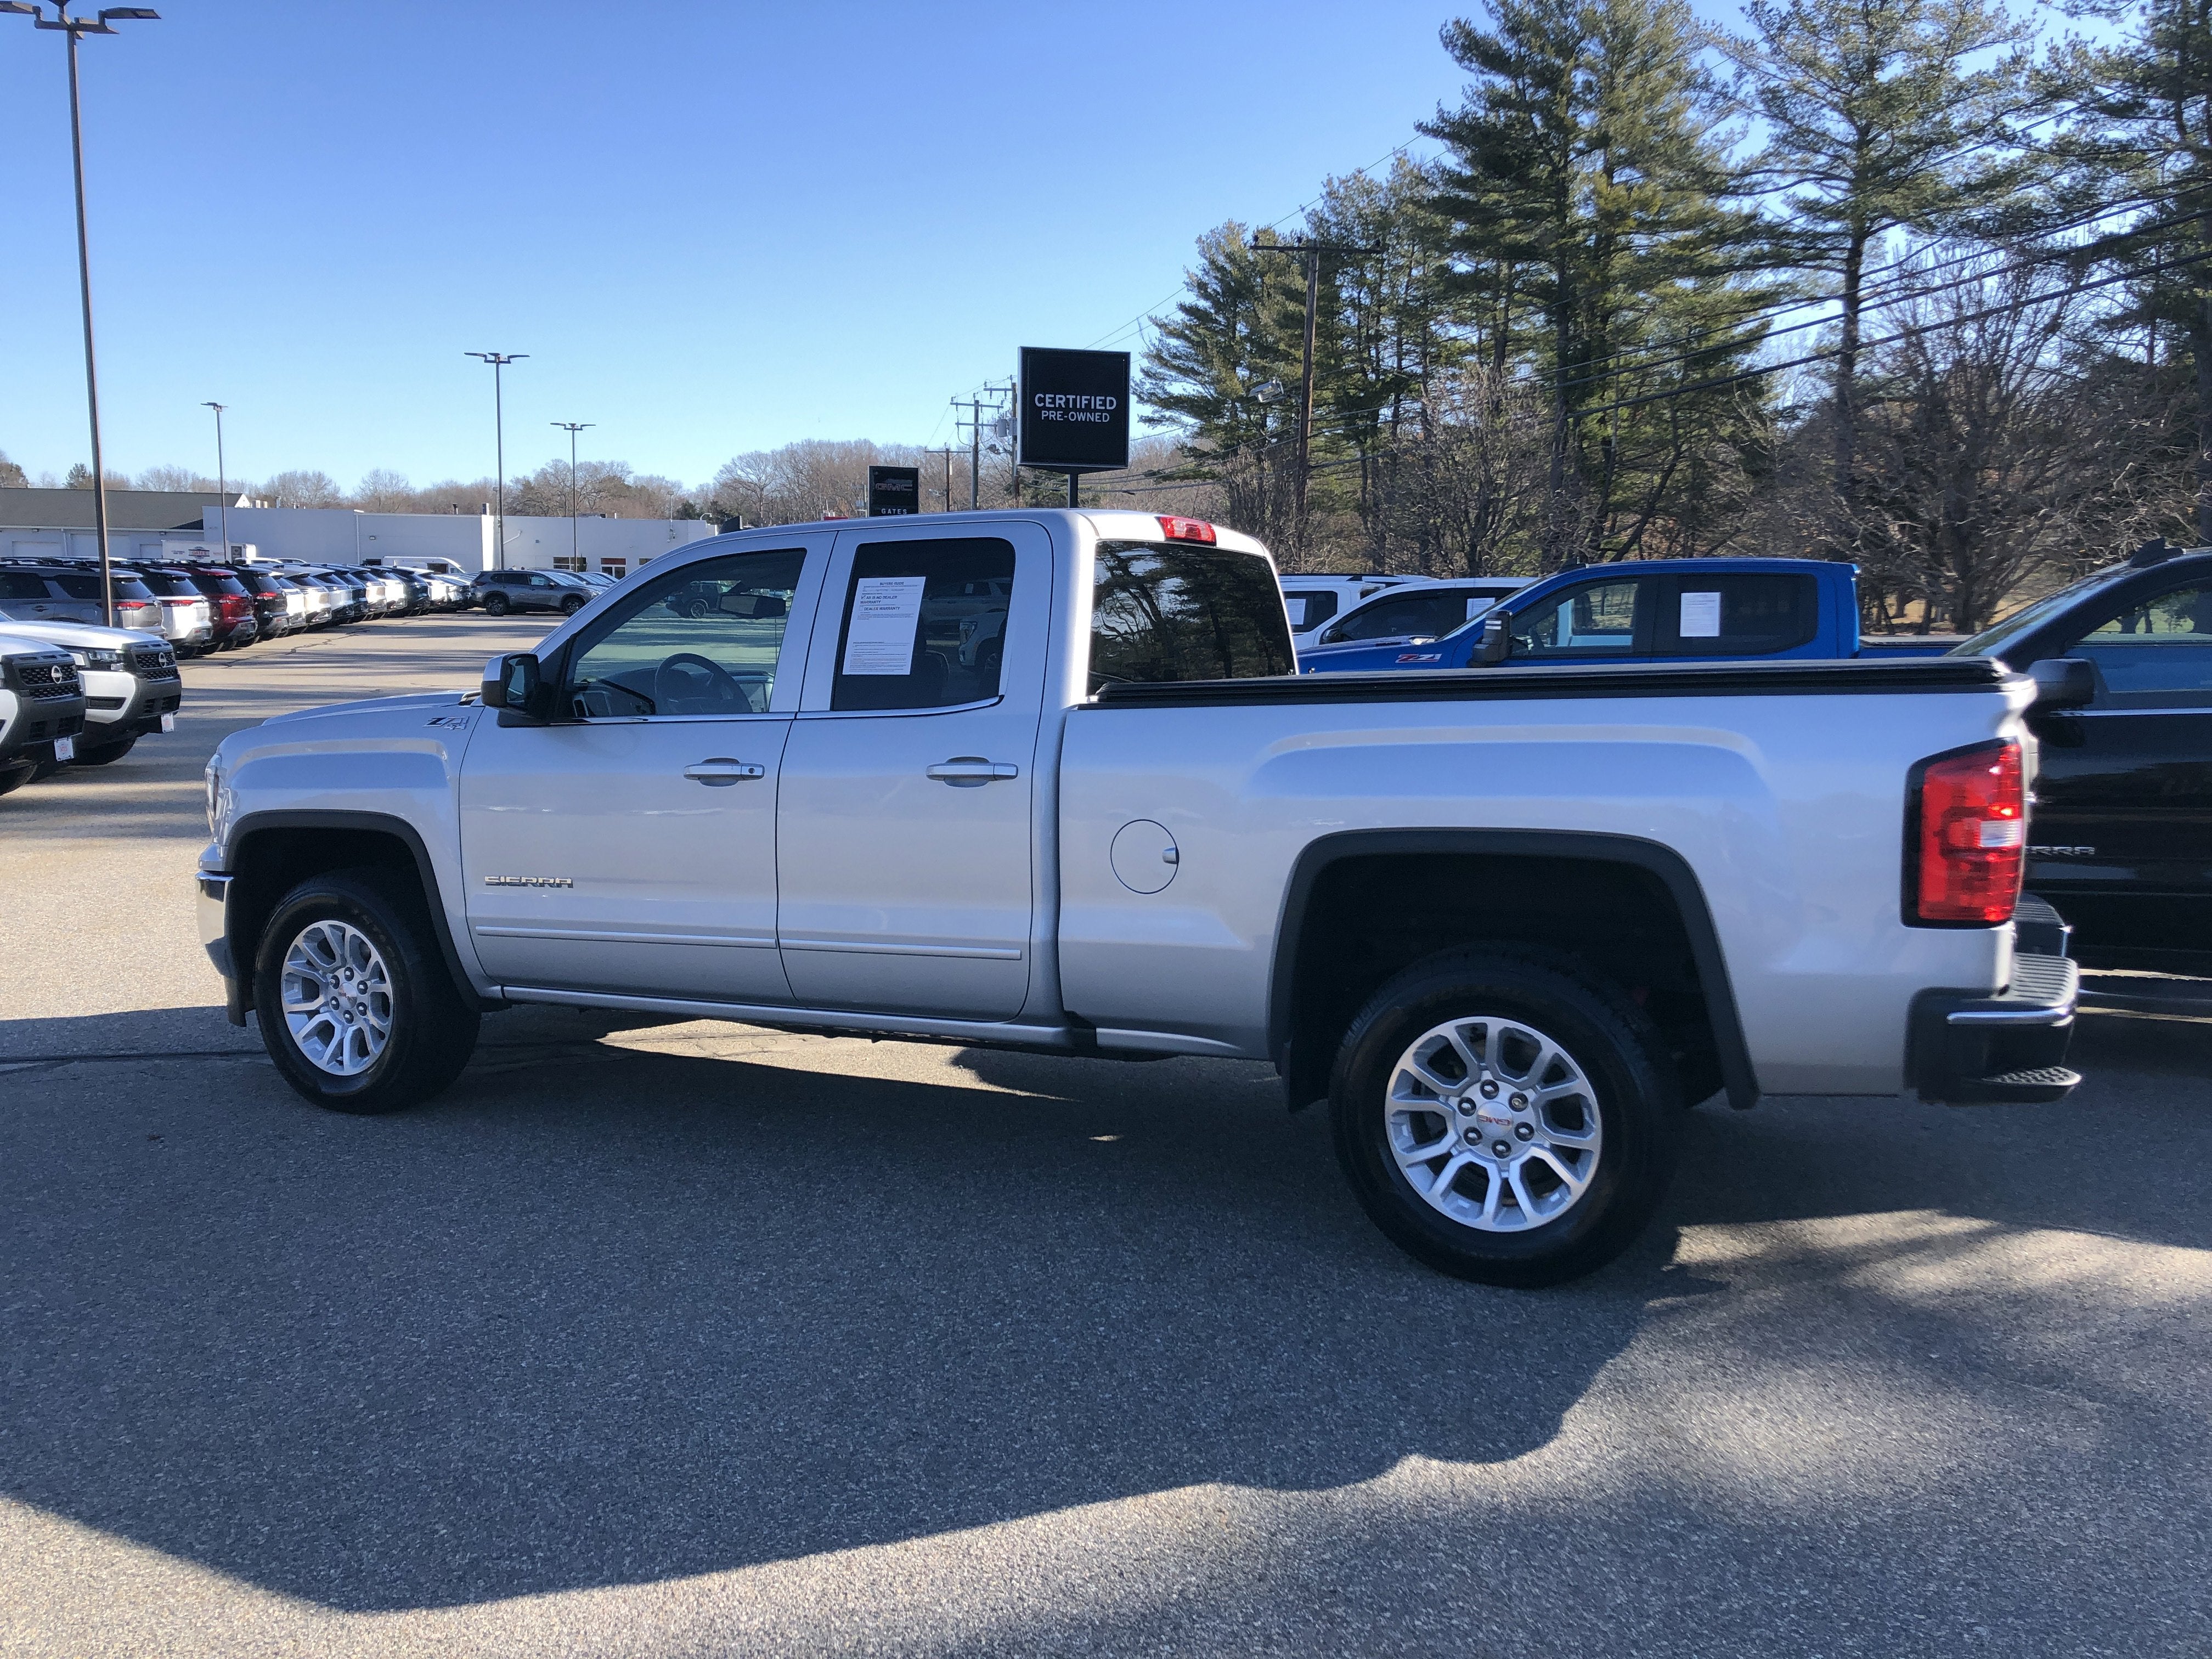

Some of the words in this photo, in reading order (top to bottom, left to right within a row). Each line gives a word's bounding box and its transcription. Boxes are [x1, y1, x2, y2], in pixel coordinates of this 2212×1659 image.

[1035, 393, 1117, 410] CERTIFIED
[1041, 410, 1110, 422] PRE-OWNED
[875, 483, 913, 492] GMC
[1395, 653, 1443, 663] Z71
[484, 876, 574, 888] SIERRA
